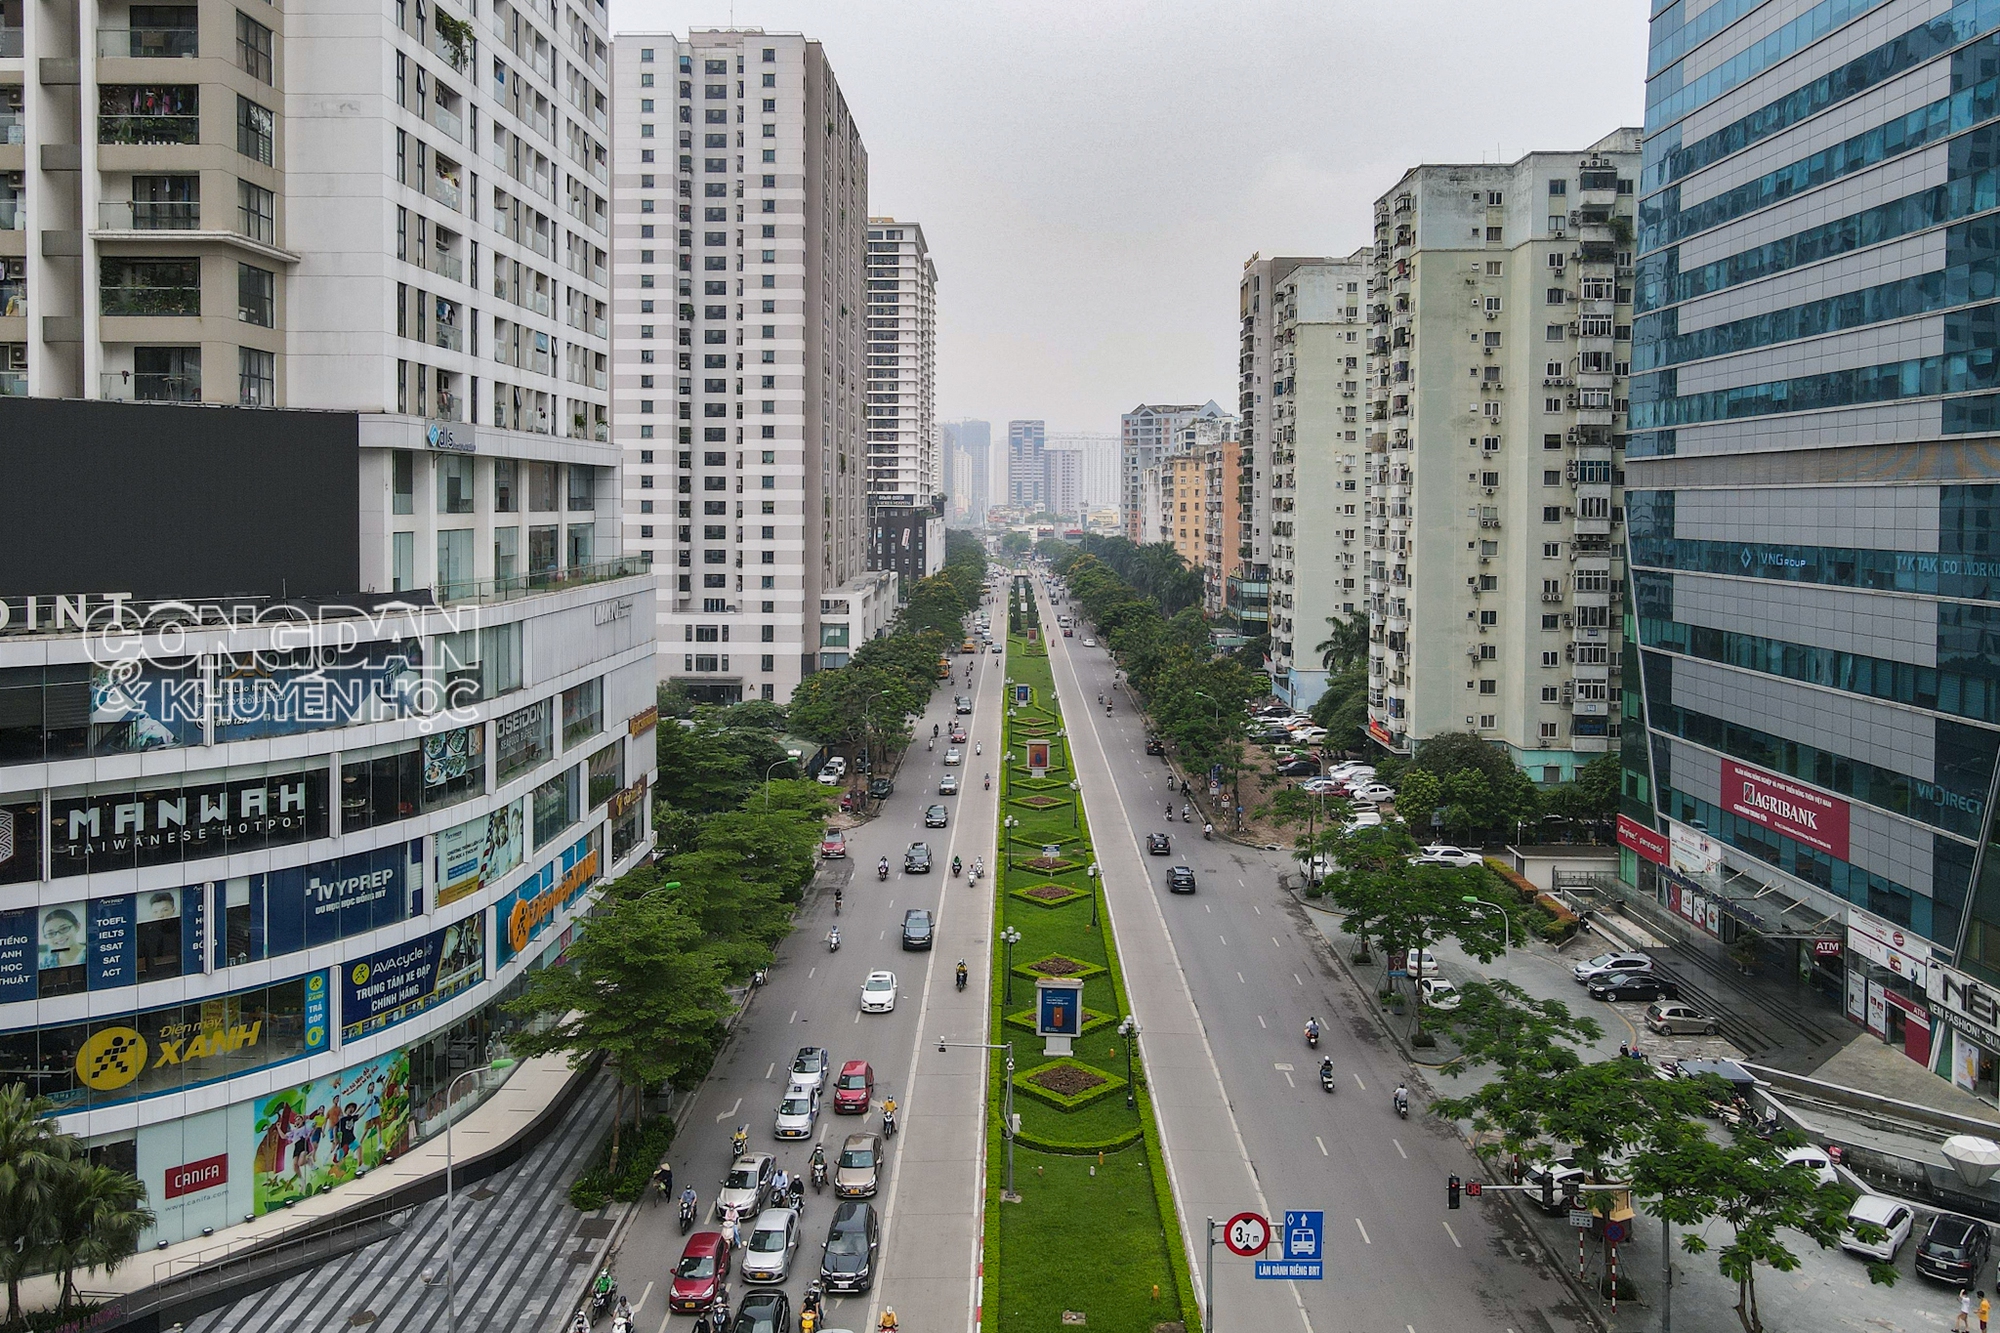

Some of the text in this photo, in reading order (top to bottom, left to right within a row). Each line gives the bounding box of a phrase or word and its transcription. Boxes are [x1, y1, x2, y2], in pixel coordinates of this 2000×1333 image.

[0, 592, 132, 631] INT
[69, 782, 306, 841] MANWAH
[1755, 791, 1818, 831] AGRIBANK
[68, 816, 306, 857] TAIWANESE HOTPOT
[96, 916, 127, 927] TOEFL
[98, 929, 125, 940] IELTS
[99, 942, 124, 953] SSAT
[1815, 942, 1839, 951] ATM
[1, 950, 22, 960] ANH
[102, 955, 120, 965] SAT
[1, 963, 23, 973] HỌC
[102, 967, 122, 978] ACT
[356, 981, 386, 1001] TRUNG
[405, 970, 415, 983] XE
[371, 993, 397, 1012] CHÍNH
[1912, 1006, 1926, 1020] ATM
[159, 1023, 192, 1039] Điện
[1944, 1009, 1981, 1039] FASHION!
[152, 1020, 263, 1069] XANH
[174, 1164, 220, 1188] CANIFA
[1466, 1184, 1481, 1196] 08
[164, 1189, 230, 1212] www.canifa.com
[1258, 1263, 1320, 1276] LÀN DÀNH RIÊNG BRT
